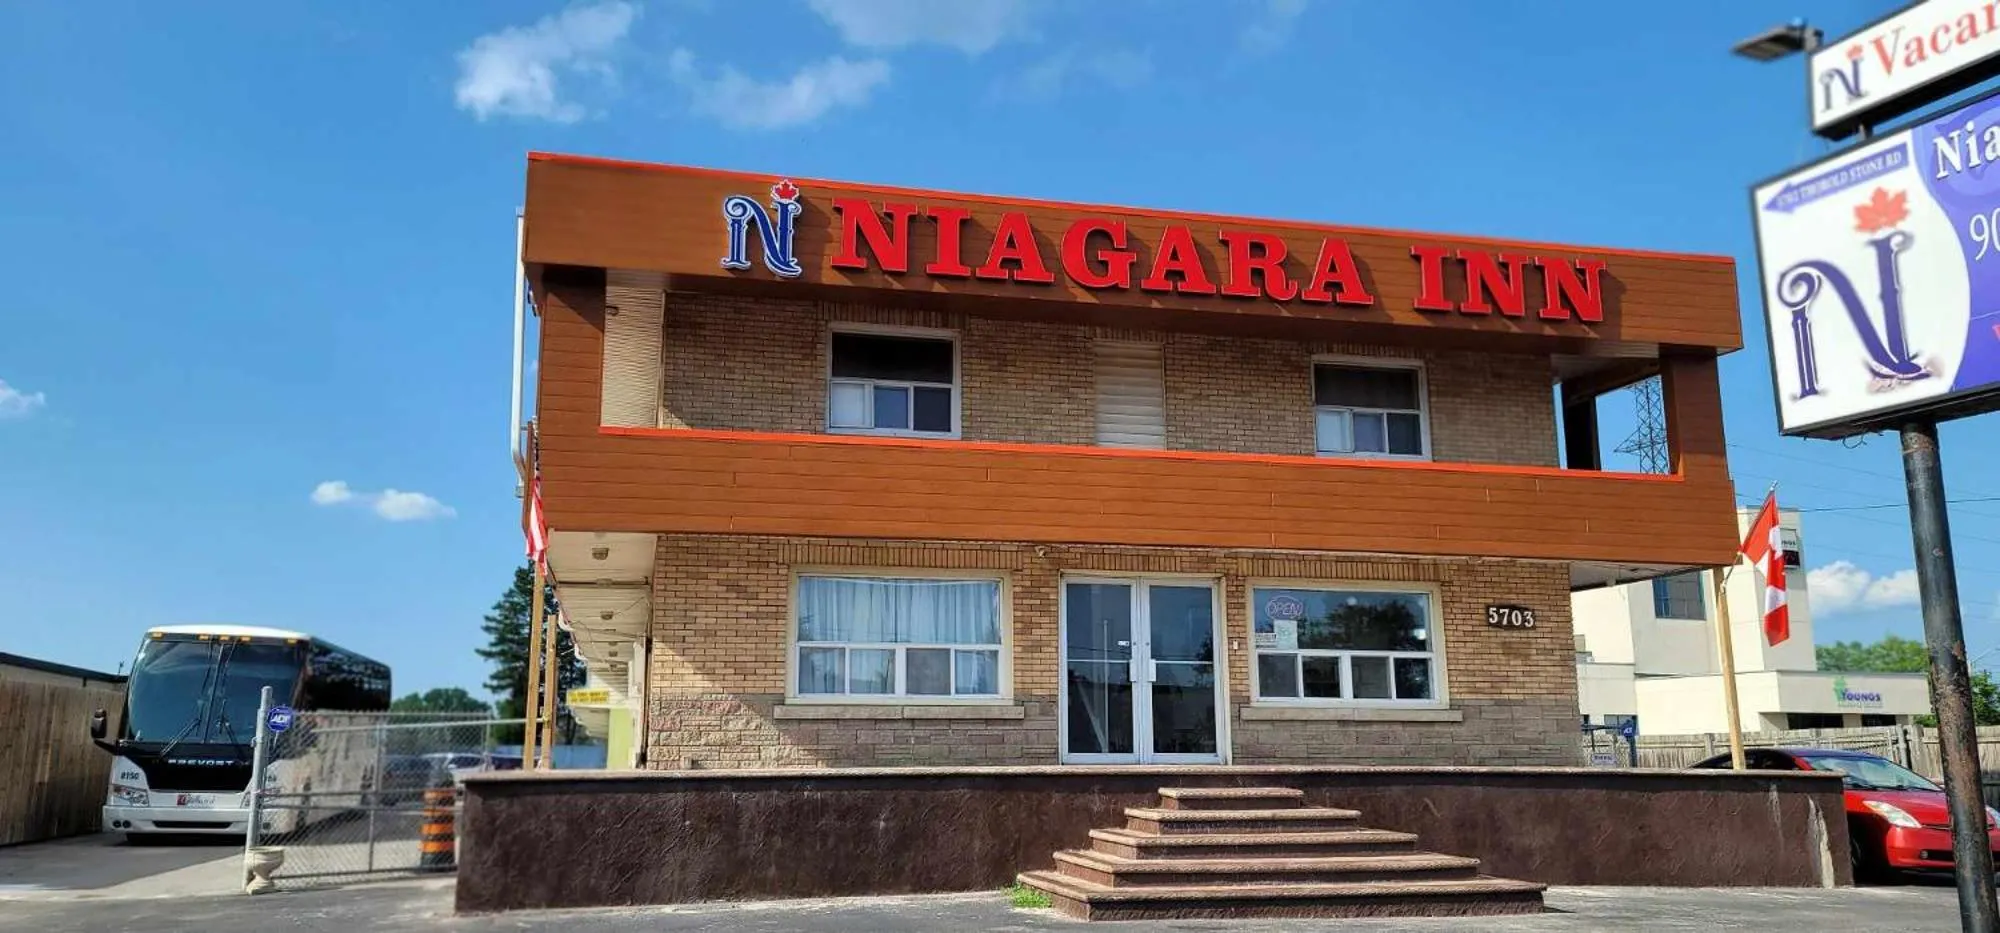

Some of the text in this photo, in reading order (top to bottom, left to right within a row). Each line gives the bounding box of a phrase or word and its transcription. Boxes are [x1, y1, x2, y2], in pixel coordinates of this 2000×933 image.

[1850, 156, 1883, 180] STONE
[1885, 149, 1901, 167] RD
[830, 197, 1375, 306] NIAGARA
[1410, 245, 1607, 322] INN
[1489, 607, 1534, 627] 5703
